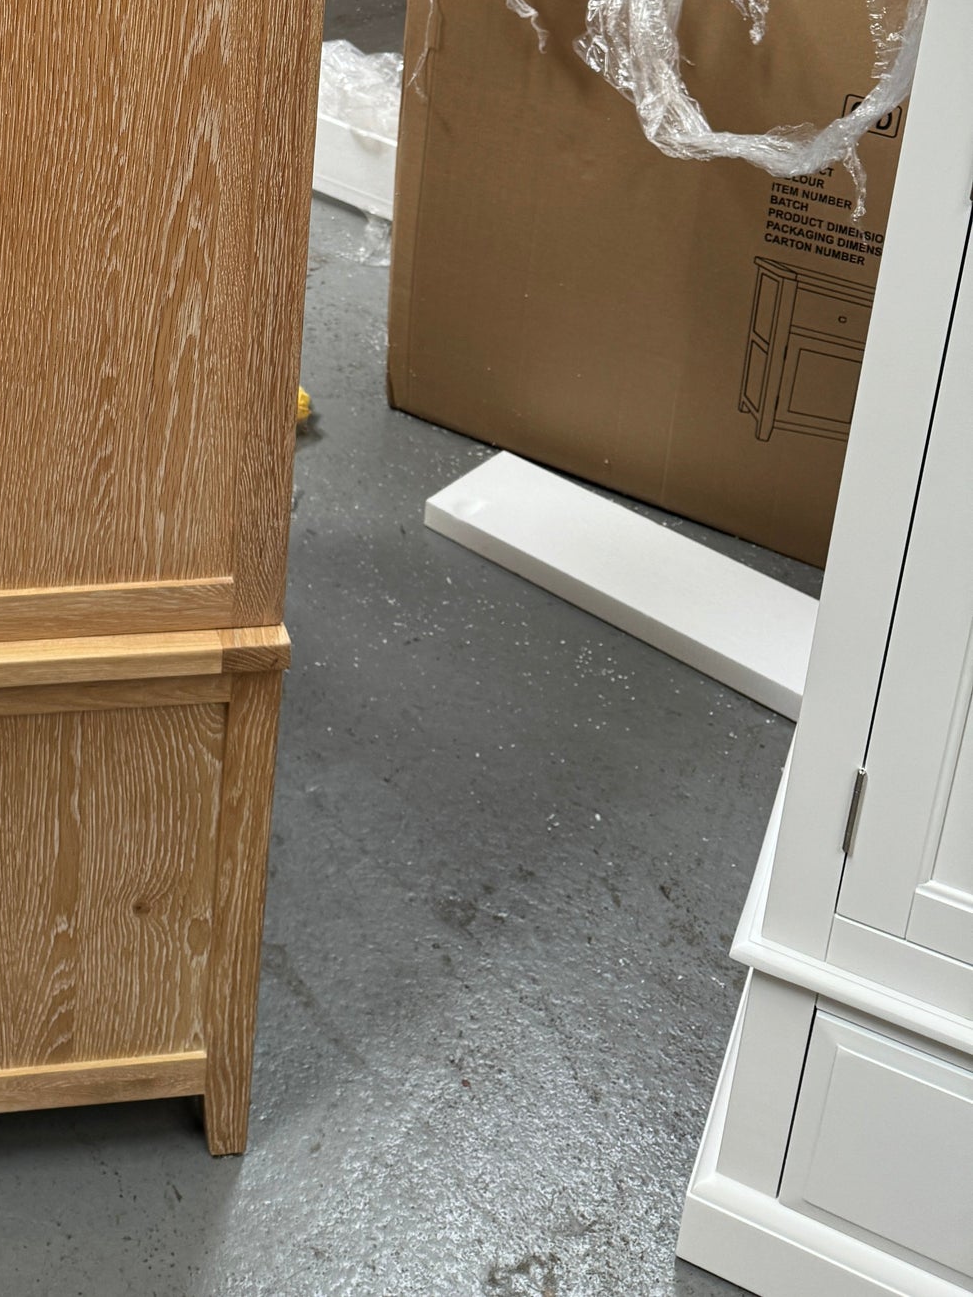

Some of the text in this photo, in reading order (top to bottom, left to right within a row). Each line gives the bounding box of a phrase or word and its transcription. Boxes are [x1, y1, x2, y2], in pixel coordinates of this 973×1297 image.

[770, 195, 809, 212] BATCH
[771, 182, 853, 210] ITEM NUMBER
[768, 208, 824, 228] PRODUCT
[764, 233, 866, 265] CARTON NUMBER
[766, 221, 883, 257] PACKAGING DIMENS
